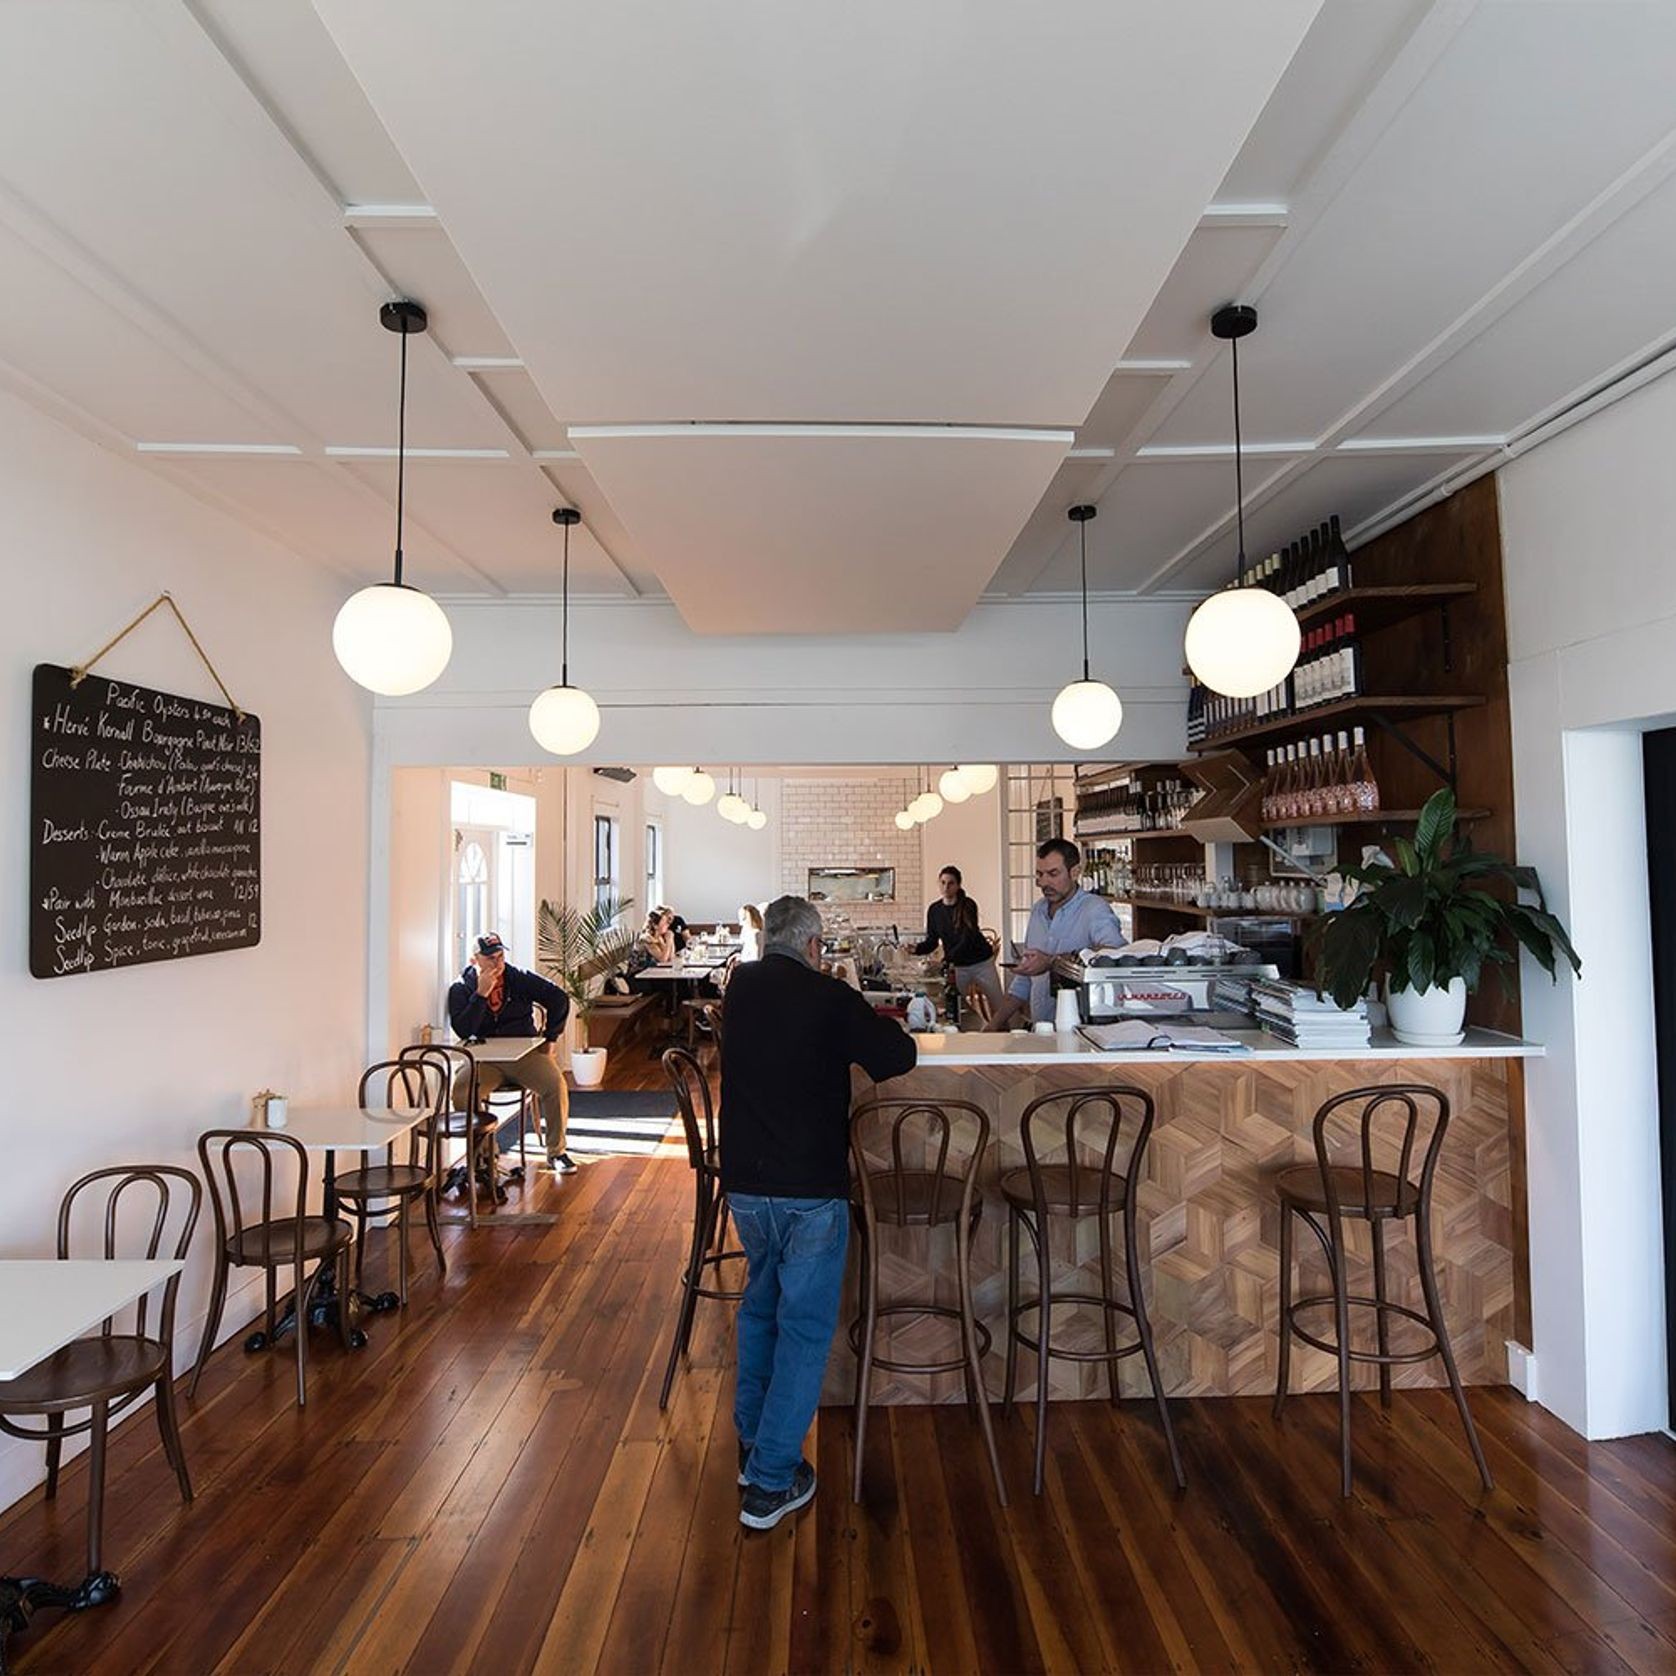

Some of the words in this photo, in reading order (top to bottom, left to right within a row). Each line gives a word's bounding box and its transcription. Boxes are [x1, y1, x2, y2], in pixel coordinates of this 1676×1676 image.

[106, 682, 146, 714] Pacific
[153, 695, 190, 723] Oysters
[42, 748, 80, 769] Cheese
[85, 748, 111, 772] Plate
[50, 887, 71, 910] Pair
[76, 887, 95, 909] with
